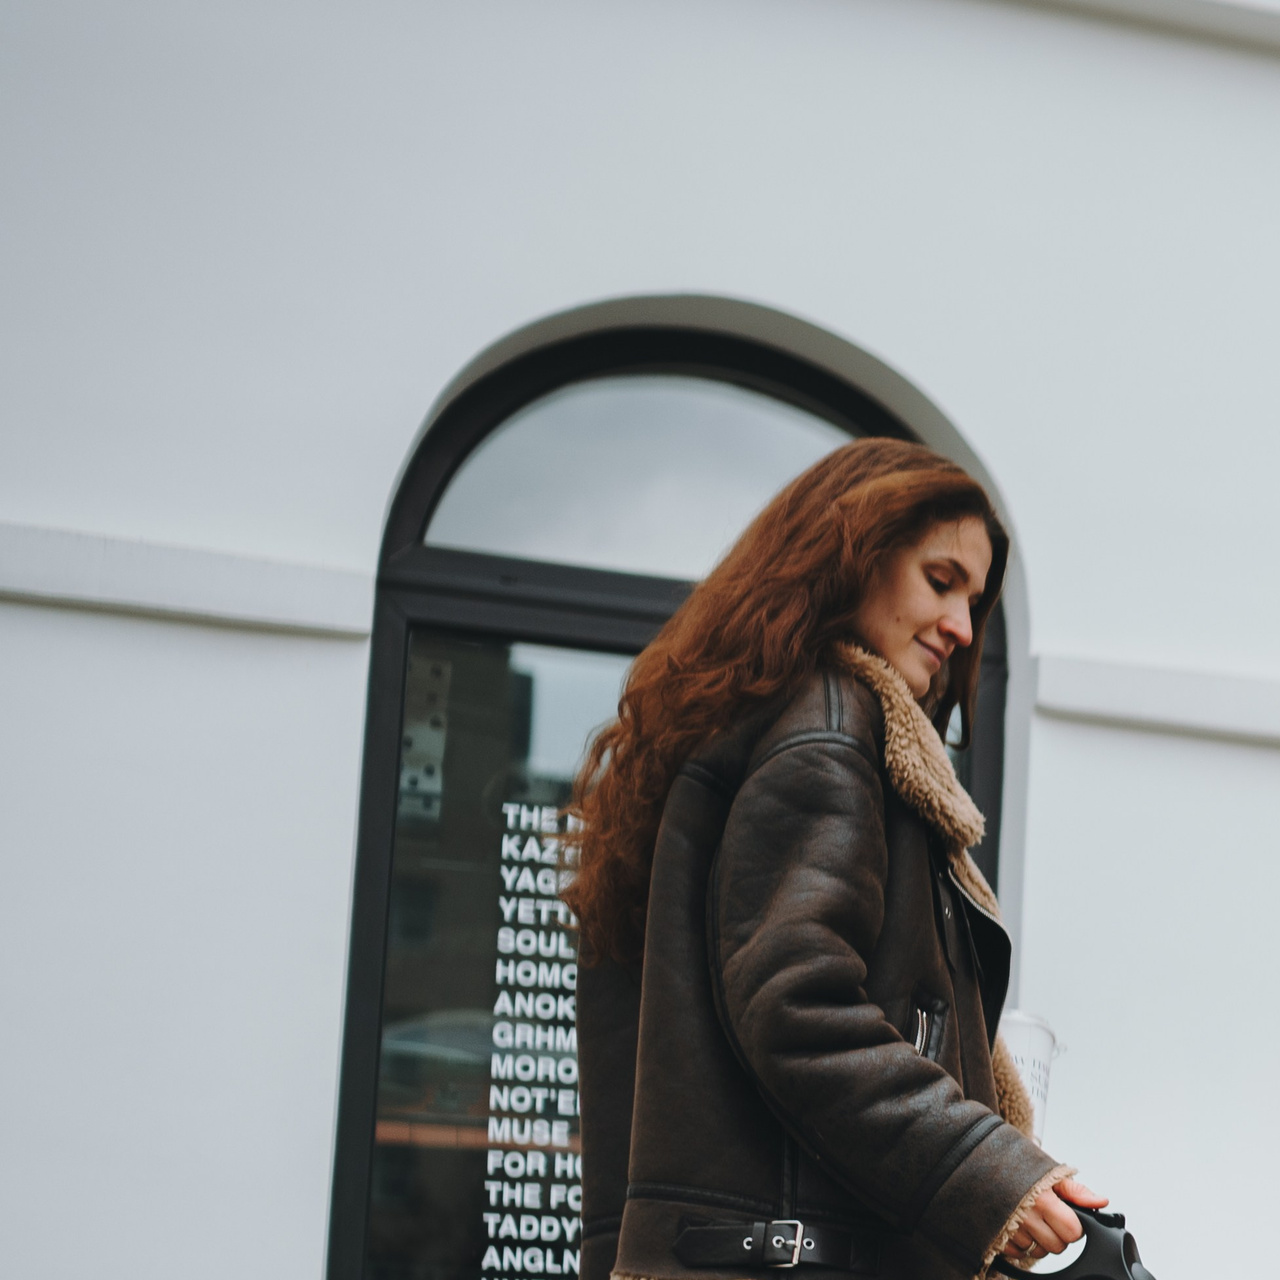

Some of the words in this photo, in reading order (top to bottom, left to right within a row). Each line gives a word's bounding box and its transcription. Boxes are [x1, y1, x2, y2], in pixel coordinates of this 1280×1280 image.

[502, 802, 559, 833] THE
[490, 1053, 579, 1085] MORO
[489, 1085, 580, 1116] NOT'E
[487, 1116, 570, 1148] MUSE
[486, 1149, 546, 1178] FOR
[484, 1180, 542, 1209] THE
[482, 1212, 583, 1243] TADDY
